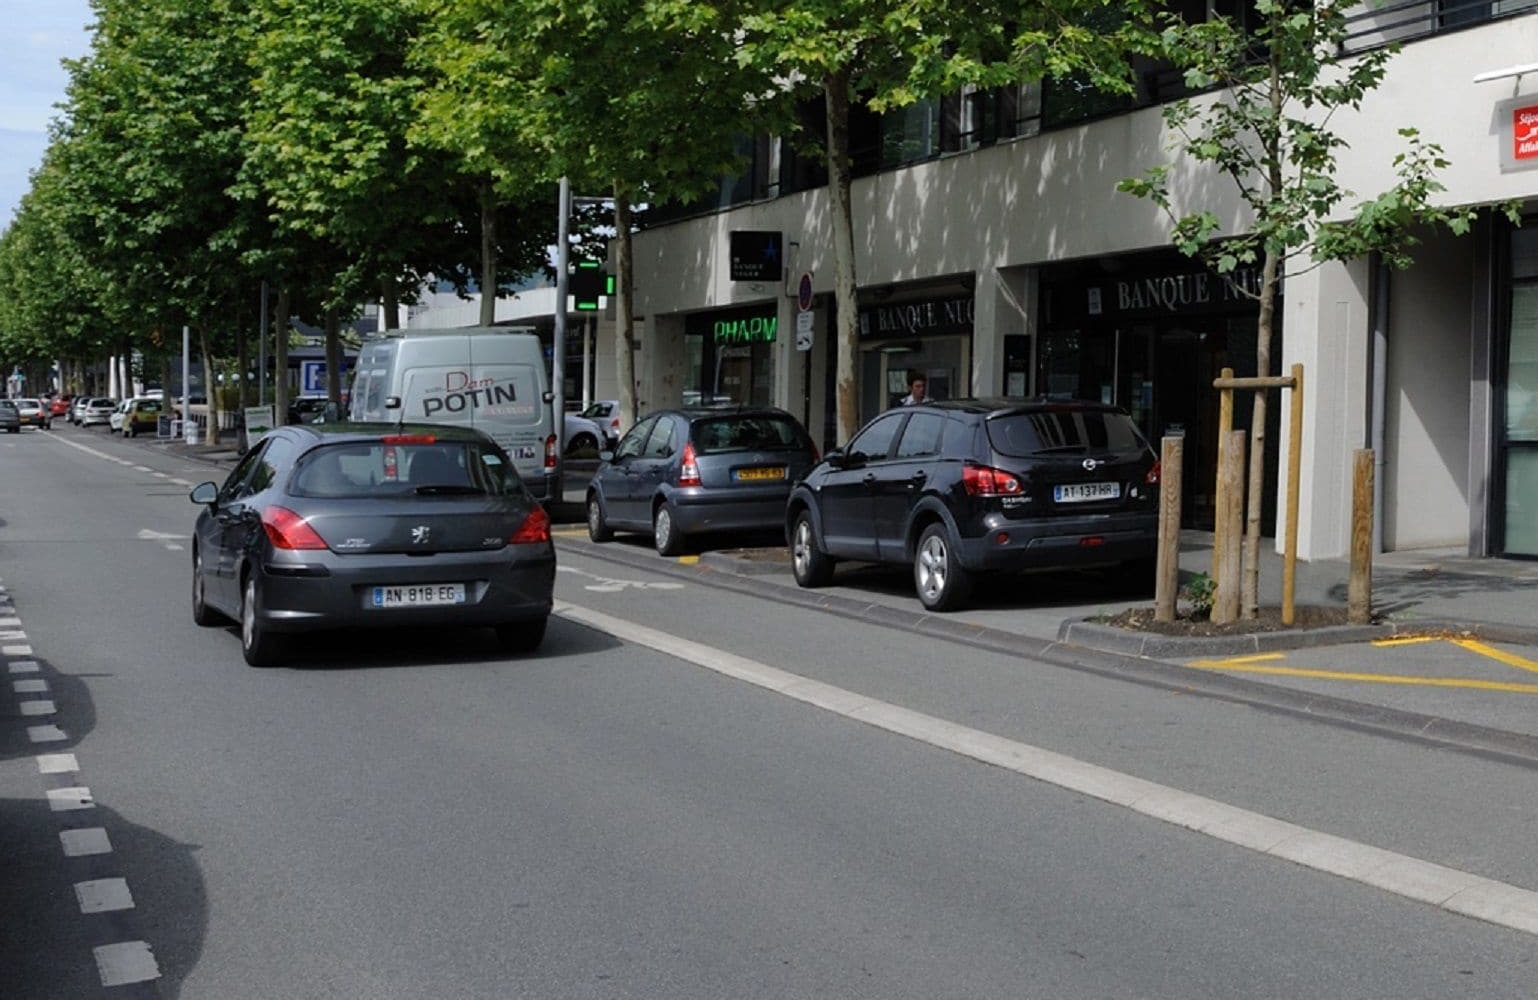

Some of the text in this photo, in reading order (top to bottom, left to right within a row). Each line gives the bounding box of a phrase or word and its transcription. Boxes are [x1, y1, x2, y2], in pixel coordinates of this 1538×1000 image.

[1117, 272, 1211, 311] BANQUE
[878, 302, 938, 334] BANQUE
[422, 382, 518, 418] POTIN
